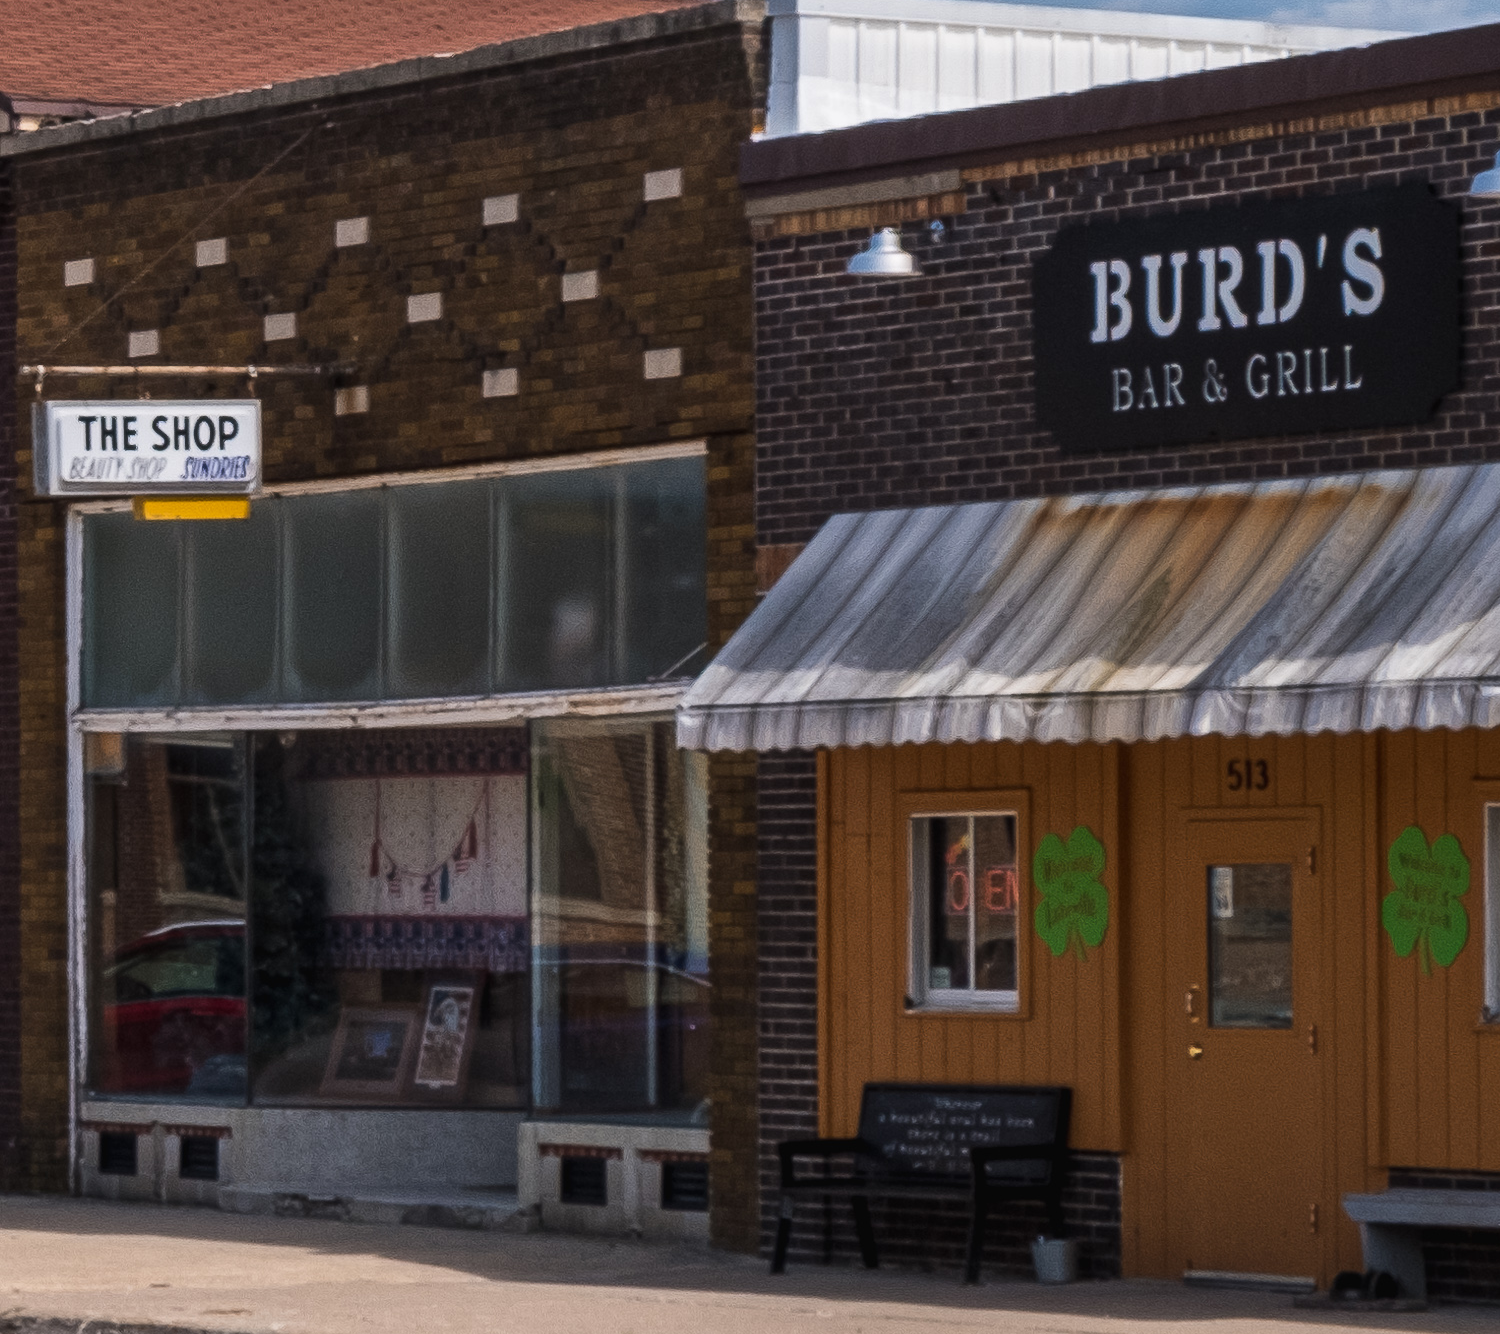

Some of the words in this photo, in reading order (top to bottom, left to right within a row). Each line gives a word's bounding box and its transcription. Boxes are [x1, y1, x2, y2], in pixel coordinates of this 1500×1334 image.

[1089, 227, 1386, 344] BURD'S
[1112, 362, 1186, 412] BAR
[1202, 359, 1228, 402] &
[1245, 345, 1363, 399] GRILL
[77, 415, 138, 452] THE
[151, 415, 240, 452] SHOP
[69, 455, 124, 480] BEAUTY
[126, 455, 168, 480] SHOP
[180, 454, 251, 481] SUNDRIES
[1227, 759, 1270, 792] 513
